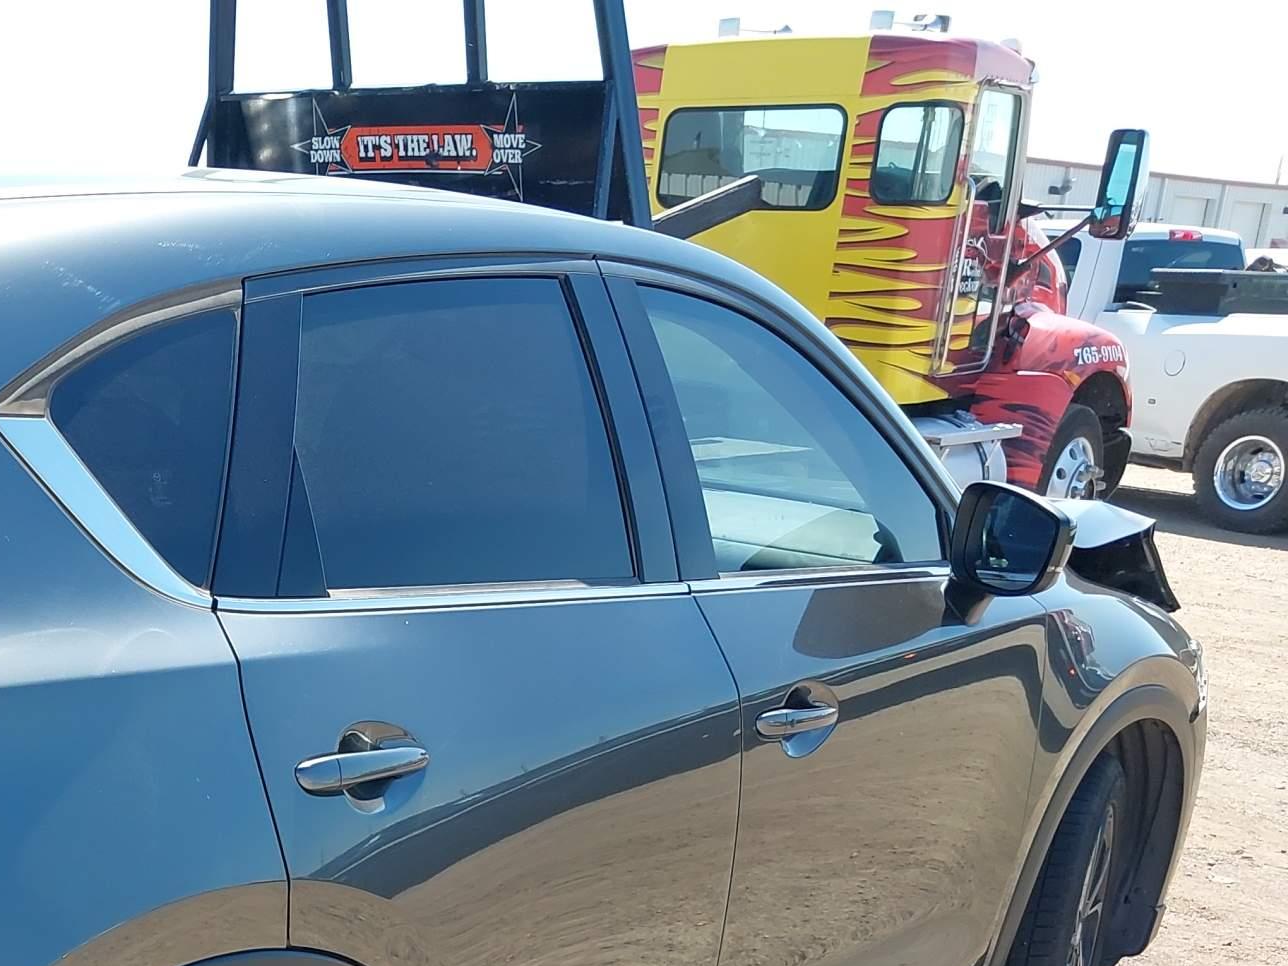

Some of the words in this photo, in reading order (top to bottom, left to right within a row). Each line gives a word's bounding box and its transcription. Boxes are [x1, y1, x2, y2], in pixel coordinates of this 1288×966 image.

[311, 136, 341, 150] SLOW
[357, 134, 392, 158] IT'S
[395, 134, 430, 158] THE
[432, 134, 477, 158] LAW.
[493, 134, 525, 149] MOVE
[310, 149, 342, 163] DOWN
[493, 149, 523, 163] OVER
[1073, 345, 1123, 365] 765-9104
